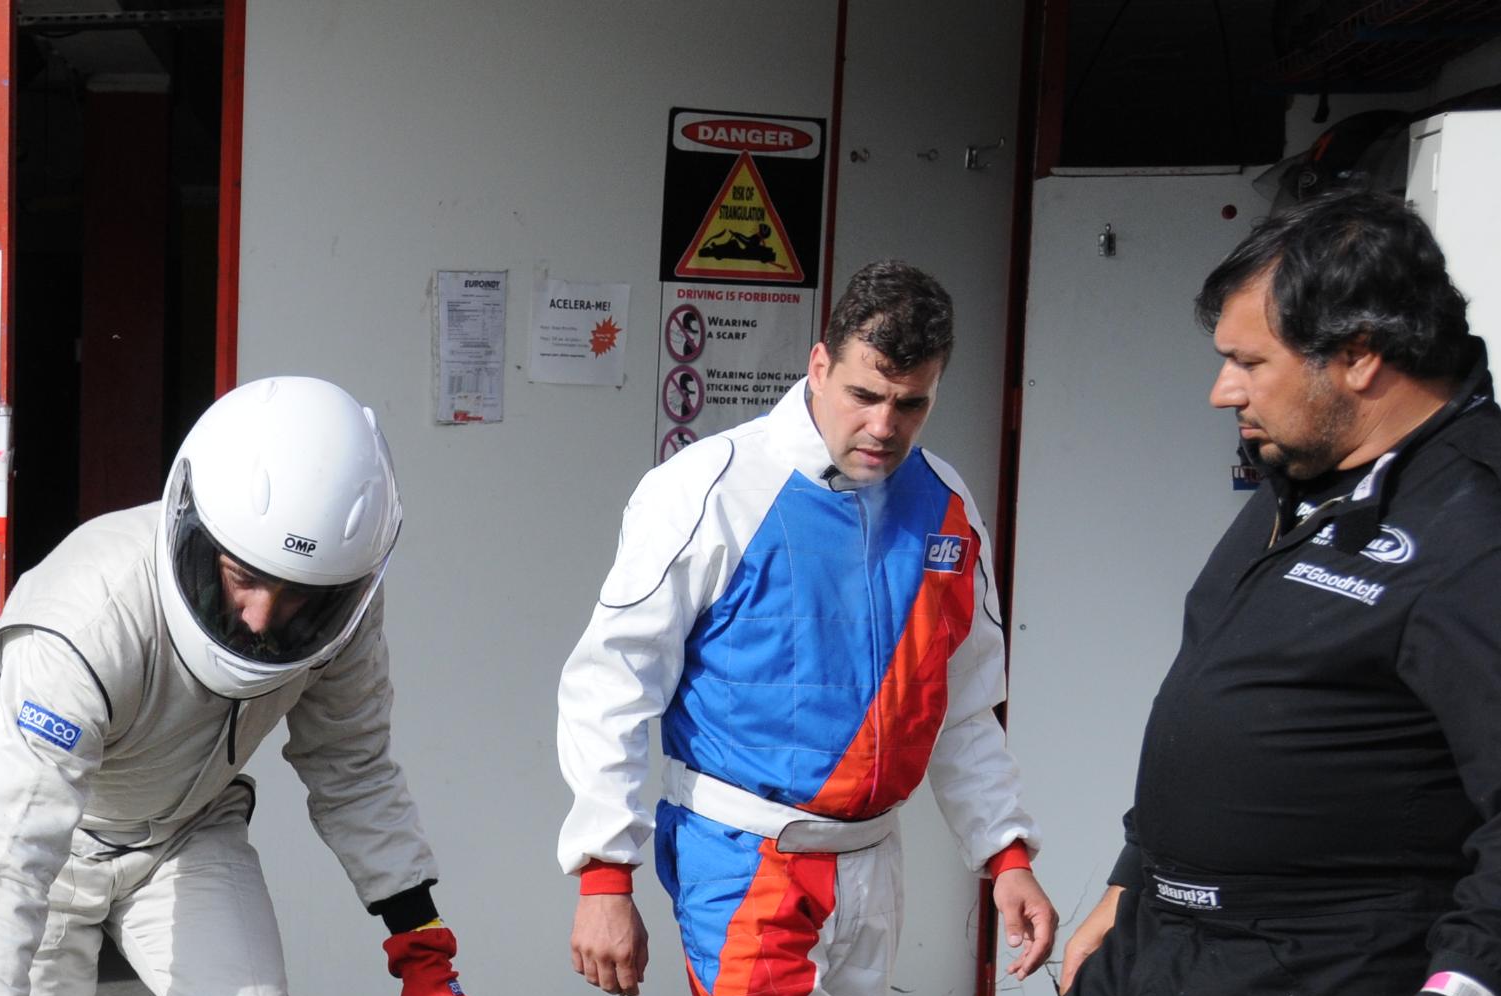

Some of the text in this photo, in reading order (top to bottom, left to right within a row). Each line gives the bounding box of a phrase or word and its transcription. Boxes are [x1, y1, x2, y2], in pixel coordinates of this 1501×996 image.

[698, 125, 794, 147] DANGER
[732, 186, 755, 201] RISK OF
[719, 205, 765, 221] STRANGULATION
[464, 279, 501, 290] EUROINDY
[677, 288, 801, 304] DRIVING IS FORBIDDEN
[549, 298, 611, 312] ACELERA-ME!
[707, 316, 758, 329] WEARING
[716, 332, 748, 341] SCARF
[706, 368, 754, 380] WEARING
[757, 372, 781, 381] LONG
[706, 384, 749, 393] STICKING
[752, 385, 771, 393] OUT
[706, 397, 738, 405] UNDER
[741, 398, 760, 406] THE
[284, 537, 316, 553] OMP
[1288, 562, 1385, 600] BFGoodrich
[20, 705, 76, 742] sparco
[1157, 883, 1217, 906] stand21
